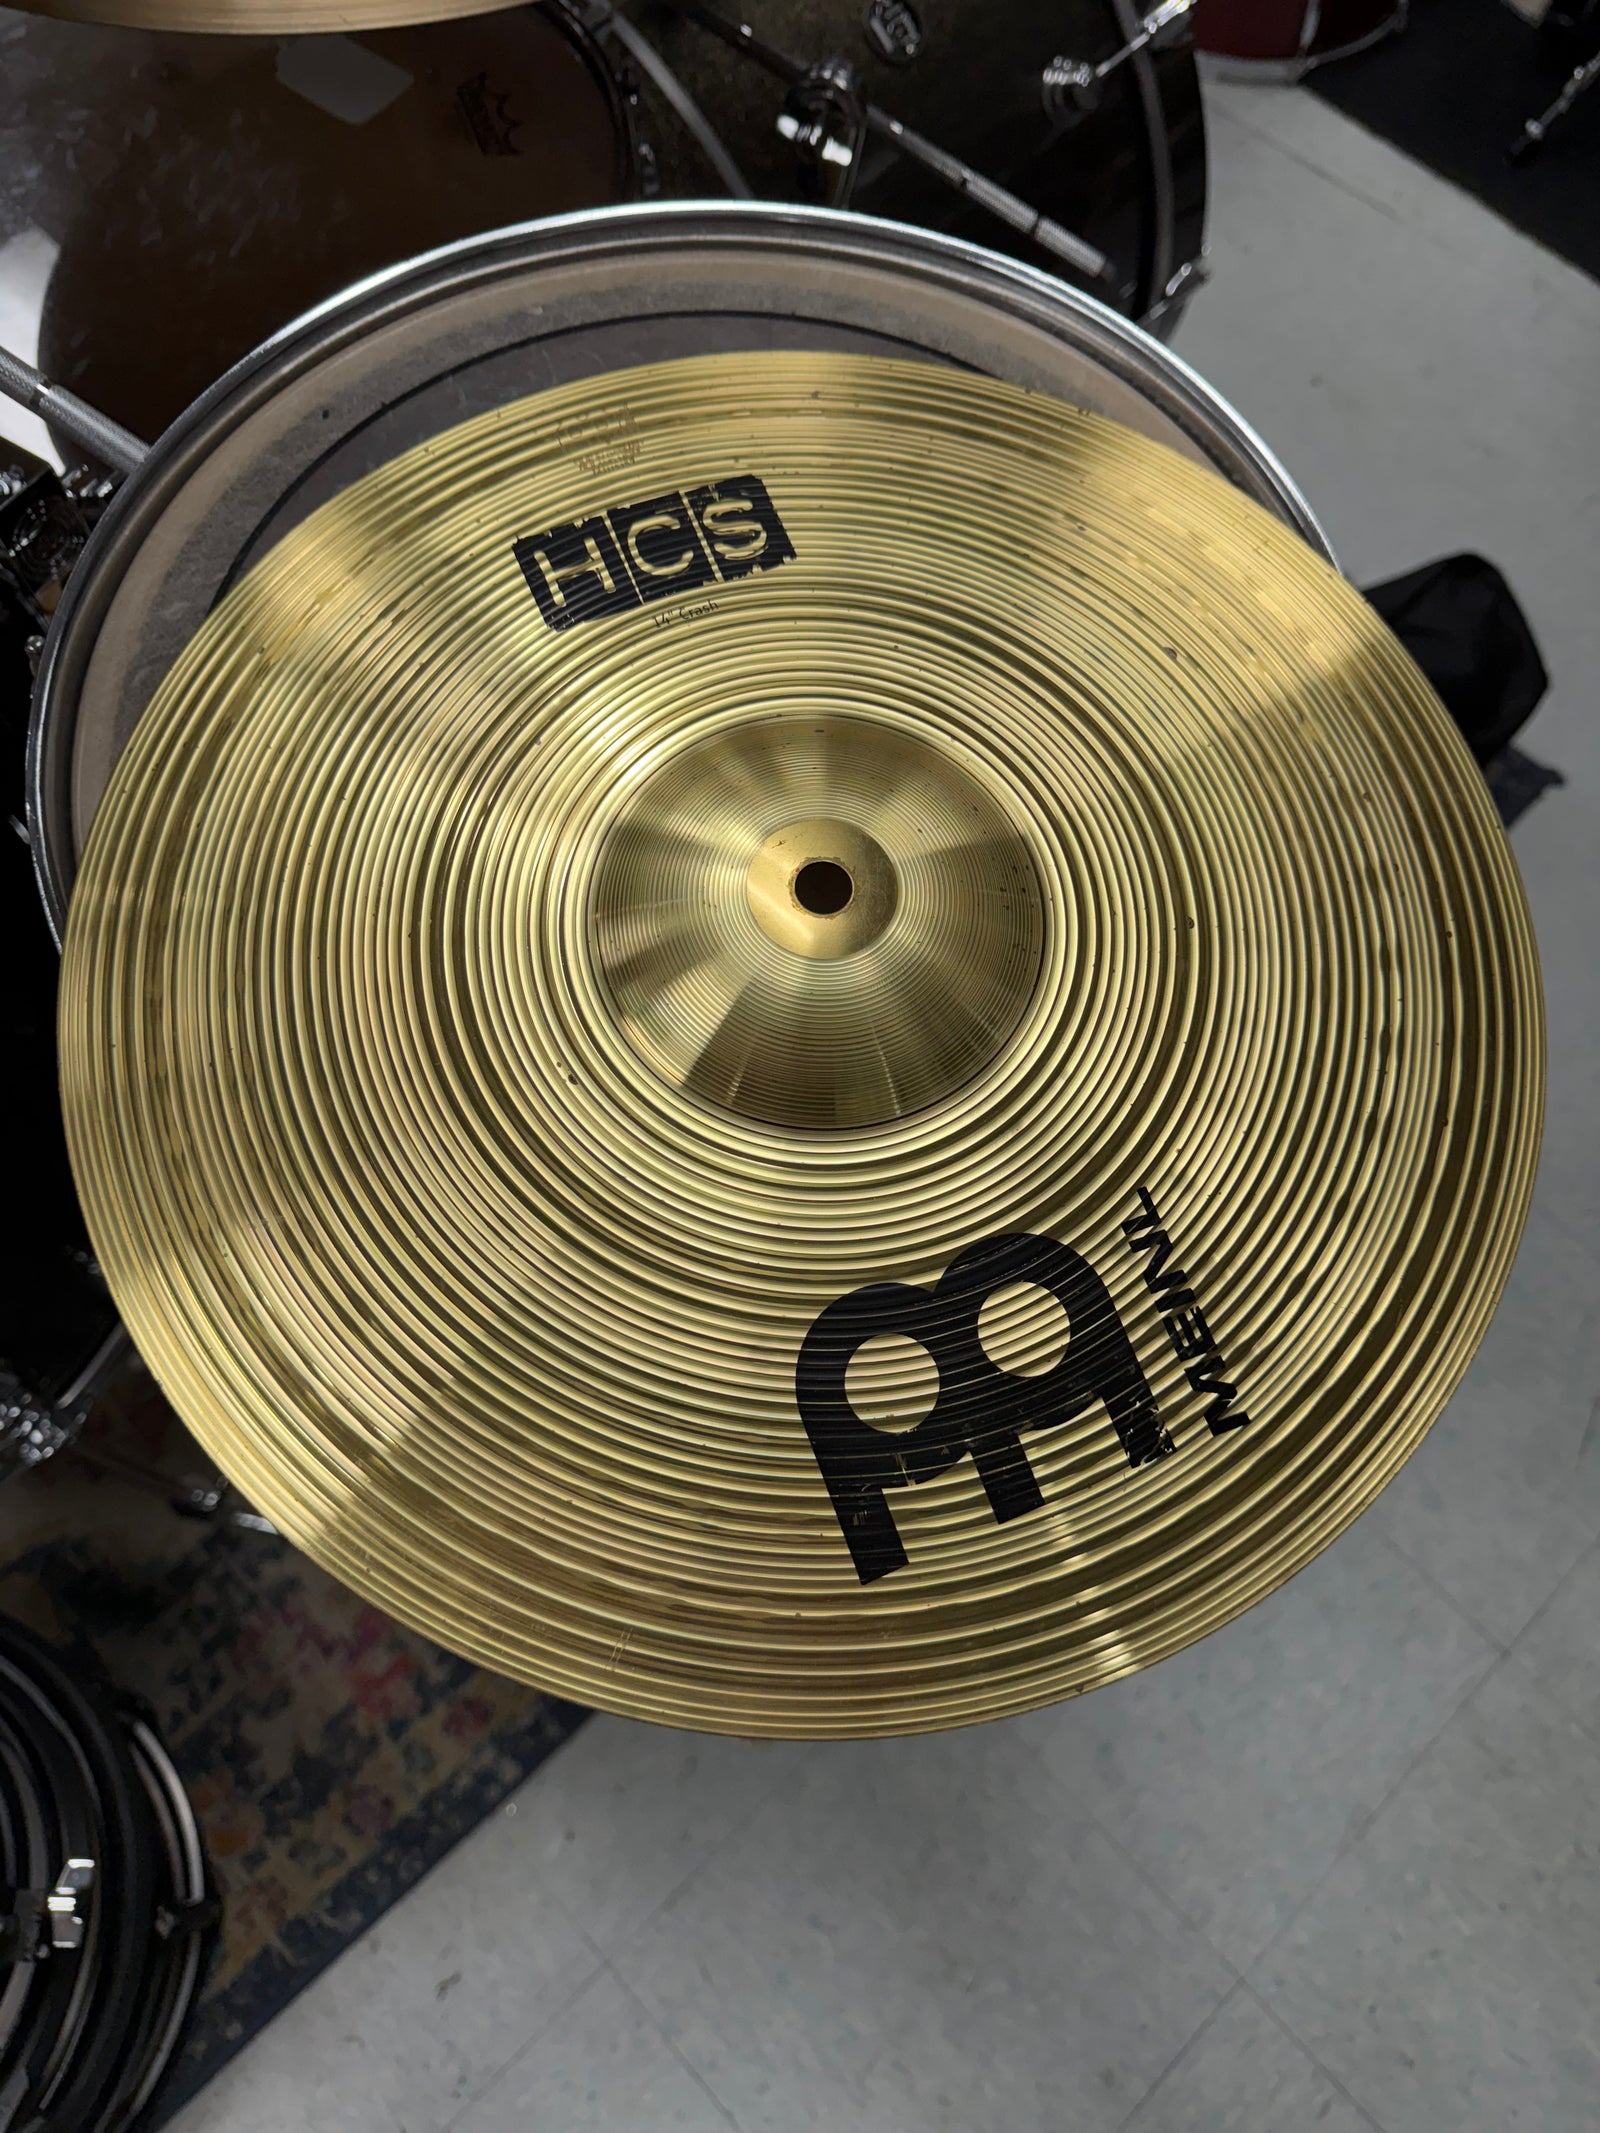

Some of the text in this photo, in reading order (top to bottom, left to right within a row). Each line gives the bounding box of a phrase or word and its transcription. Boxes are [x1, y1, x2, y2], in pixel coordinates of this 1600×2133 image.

[533, 498, 769, 608] HCS
[652, 599, 720, 628] 14" Crash
[1120, 1186, 1251, 1437] MEINL
